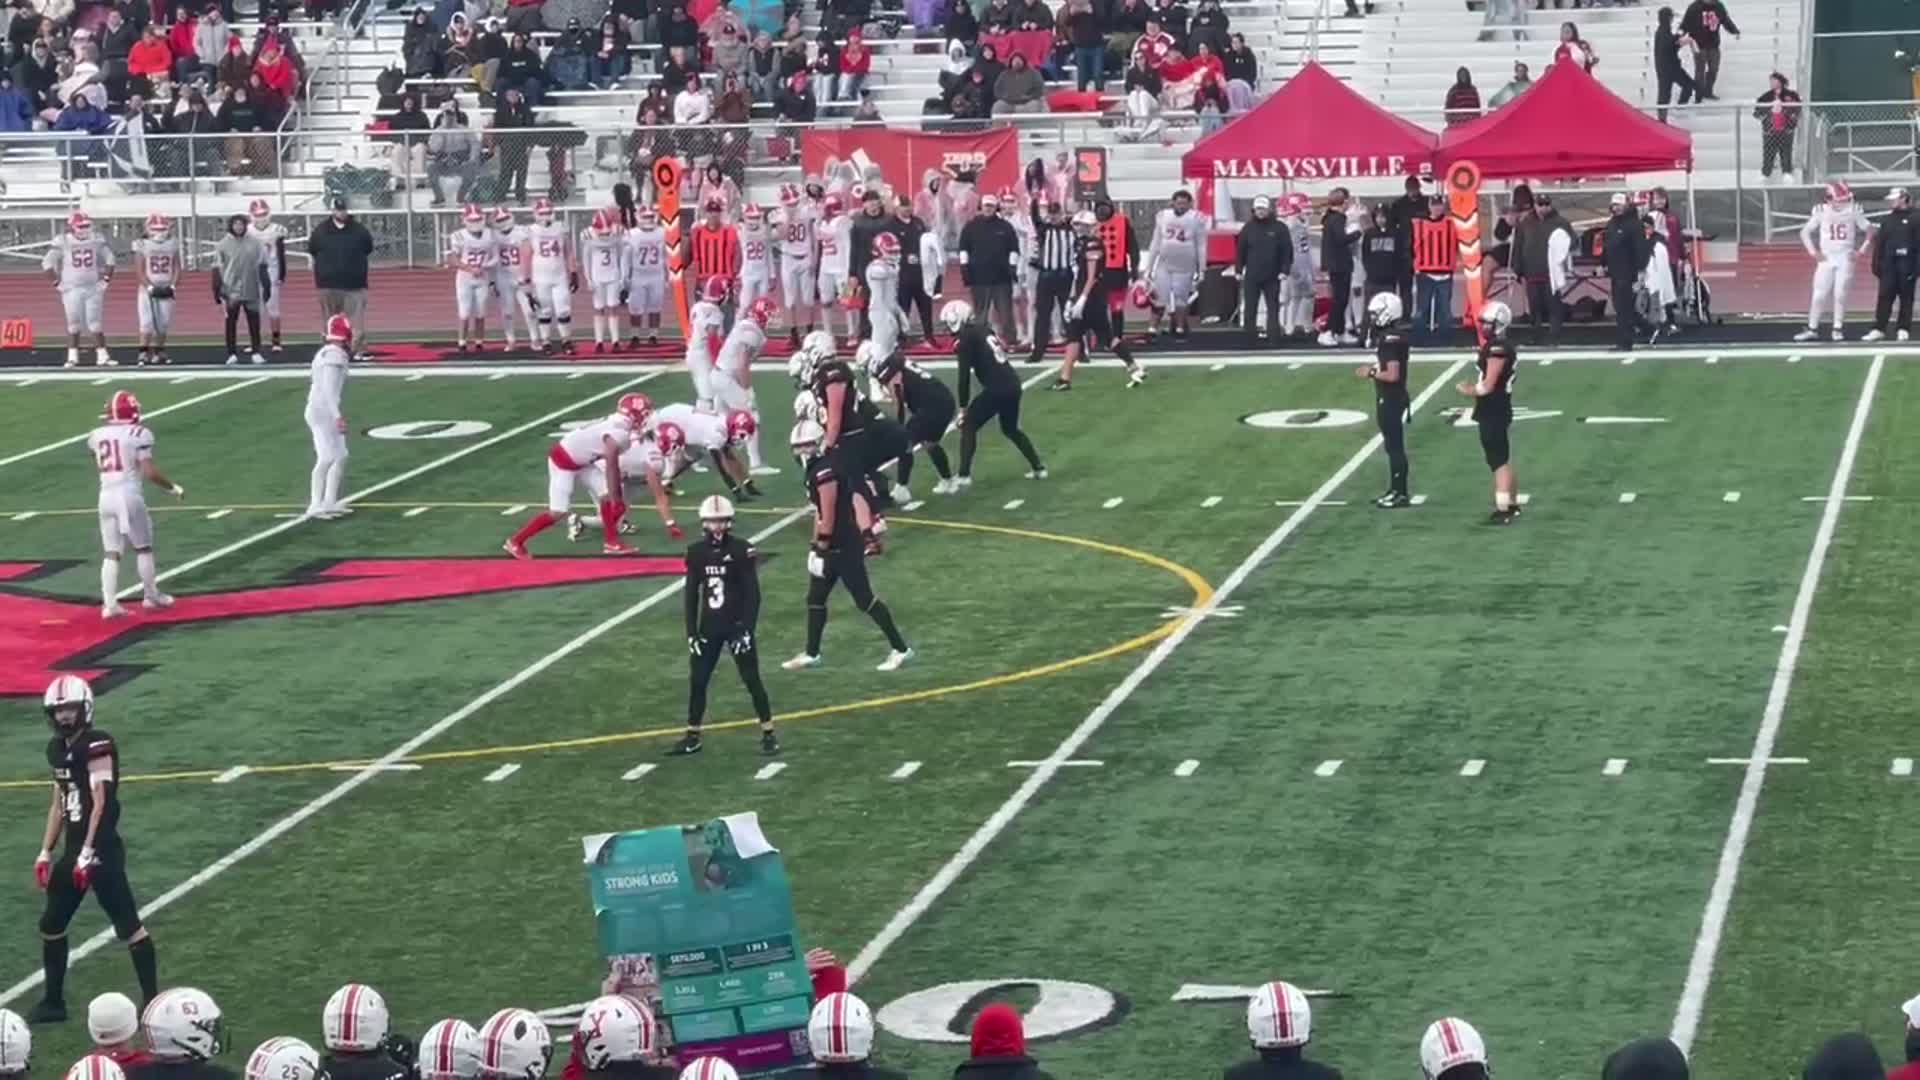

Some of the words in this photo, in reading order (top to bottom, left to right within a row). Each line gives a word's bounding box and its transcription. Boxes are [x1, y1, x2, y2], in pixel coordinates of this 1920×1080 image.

[1079, 152, 1101, 182] 3
[1213, 155, 1406, 178] MARYSVILLE
[1830, 224, 1847, 241] 16
[601, 249, 611, 267] 3
[3, 324, 26, 342] 40
[98, 439, 123, 471] 21
[708, 577, 724, 609] 3
[605, 874, 648, 889] STRONG
[650, 871, 679, 886] KIDS
[182, 1002, 199, 1015] 63
[281, 1064, 302, 1080] 25
